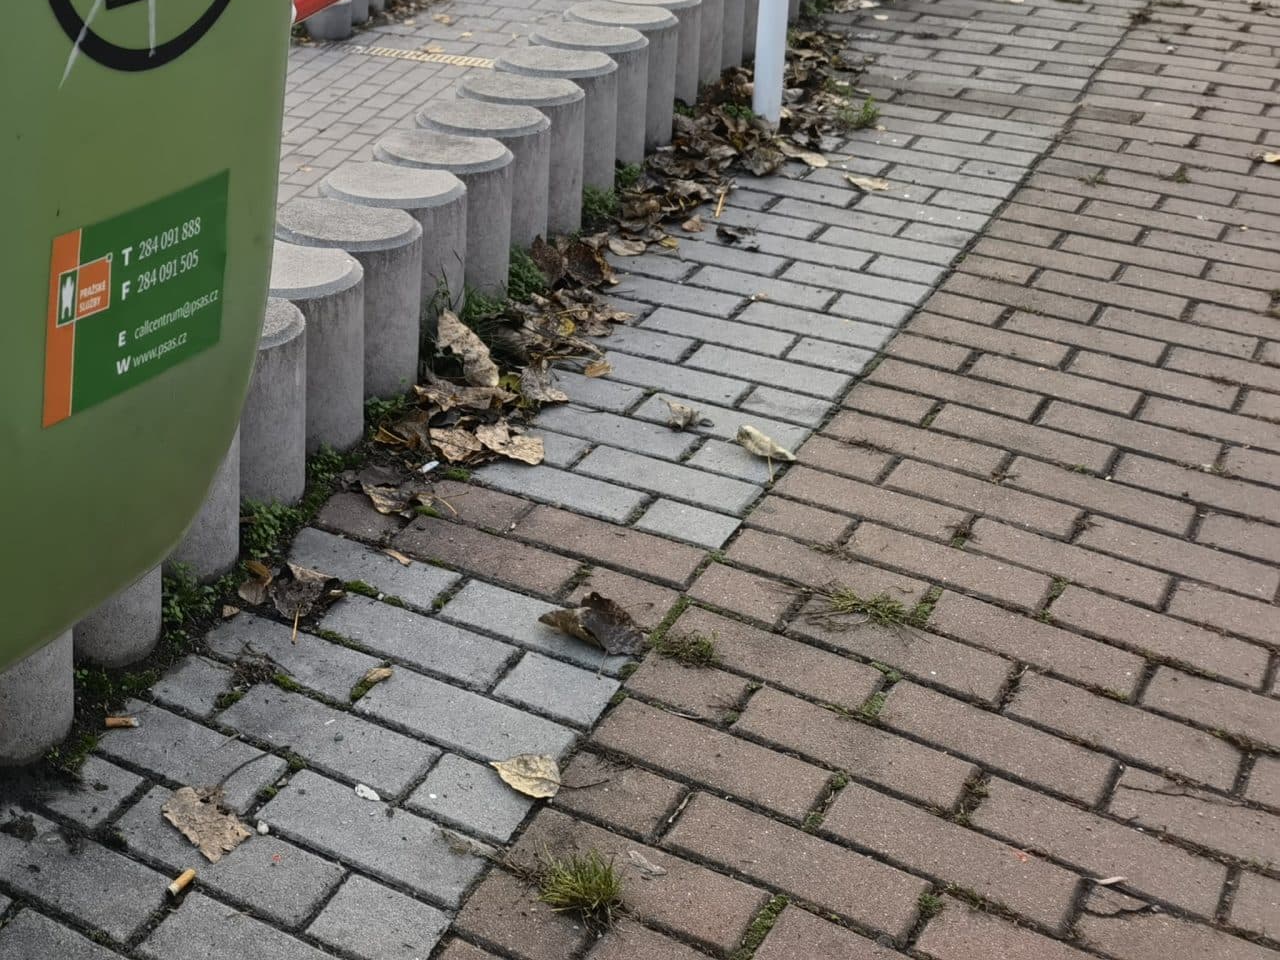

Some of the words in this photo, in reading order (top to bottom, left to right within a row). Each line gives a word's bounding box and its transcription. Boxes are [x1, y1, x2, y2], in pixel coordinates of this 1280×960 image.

[121, 246, 133, 267] T
[138, 235, 159, 260] 284
[160, 227, 179, 250] 091
[181, 216, 201, 241] 888
[121, 280, 131, 301] F
[137, 268, 157, 293] 284
[159, 259, 178, 283] 091
[180, 248, 199, 273] 505
[118, 330, 127, 348] E
[134, 289, 219, 340] callcentrum@psas.cz
[116, 355, 131, 375] W
[132, 332, 188, 368] www.psas.cz
